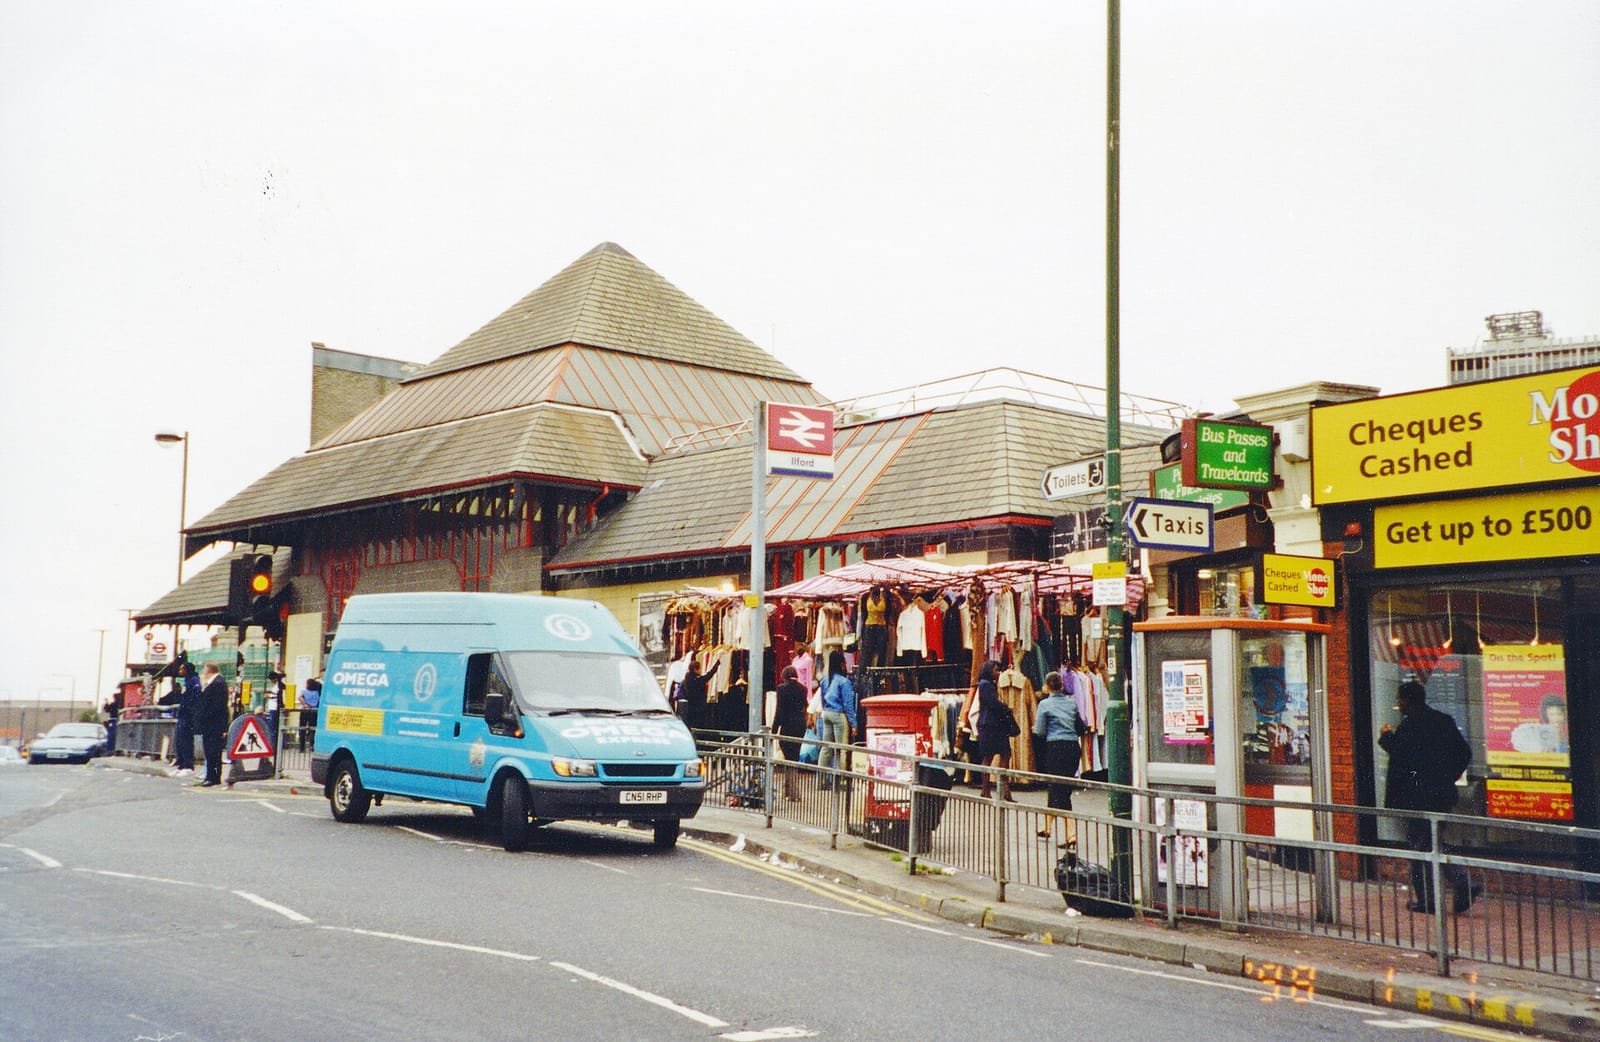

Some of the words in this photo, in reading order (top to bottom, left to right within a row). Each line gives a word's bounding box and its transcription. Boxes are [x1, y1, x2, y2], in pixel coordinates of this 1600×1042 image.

[1348, 411, 1483, 445] Cheques
[1201, 427, 1224, 444] Bus
[1227, 429, 1268, 447] Passes
[1548, 423, 1600, 464] Sh
[791, 457, 815, 467] Ilford
[1223, 448, 1246, 463] and
[1359, 441, 1473, 478] Cashed
[1053, 471, 1087, 489] Toilets
[1201, 464, 1269, 484] Travelcards
[1152, 513, 1204, 535] Taxis
[1387, 520, 1432, 544] Get
[1440, 521, 1474, 546] up
[1482, 516, 1512, 537] to
[1522, 505, 1592, 534] £500
[1264, 568, 1301, 580] Cheques
[1268, 582, 1299, 592] Cashed
[1507, 652, 1524, 662] the
[1527, 653, 1556, 663] Spot!
[332, 671, 389, 687] OMEGA
[341, 687, 376, 697] EXPRESS
[647, 791, 663, 803] RHP
[1492, 793, 1516, 801] Cash
